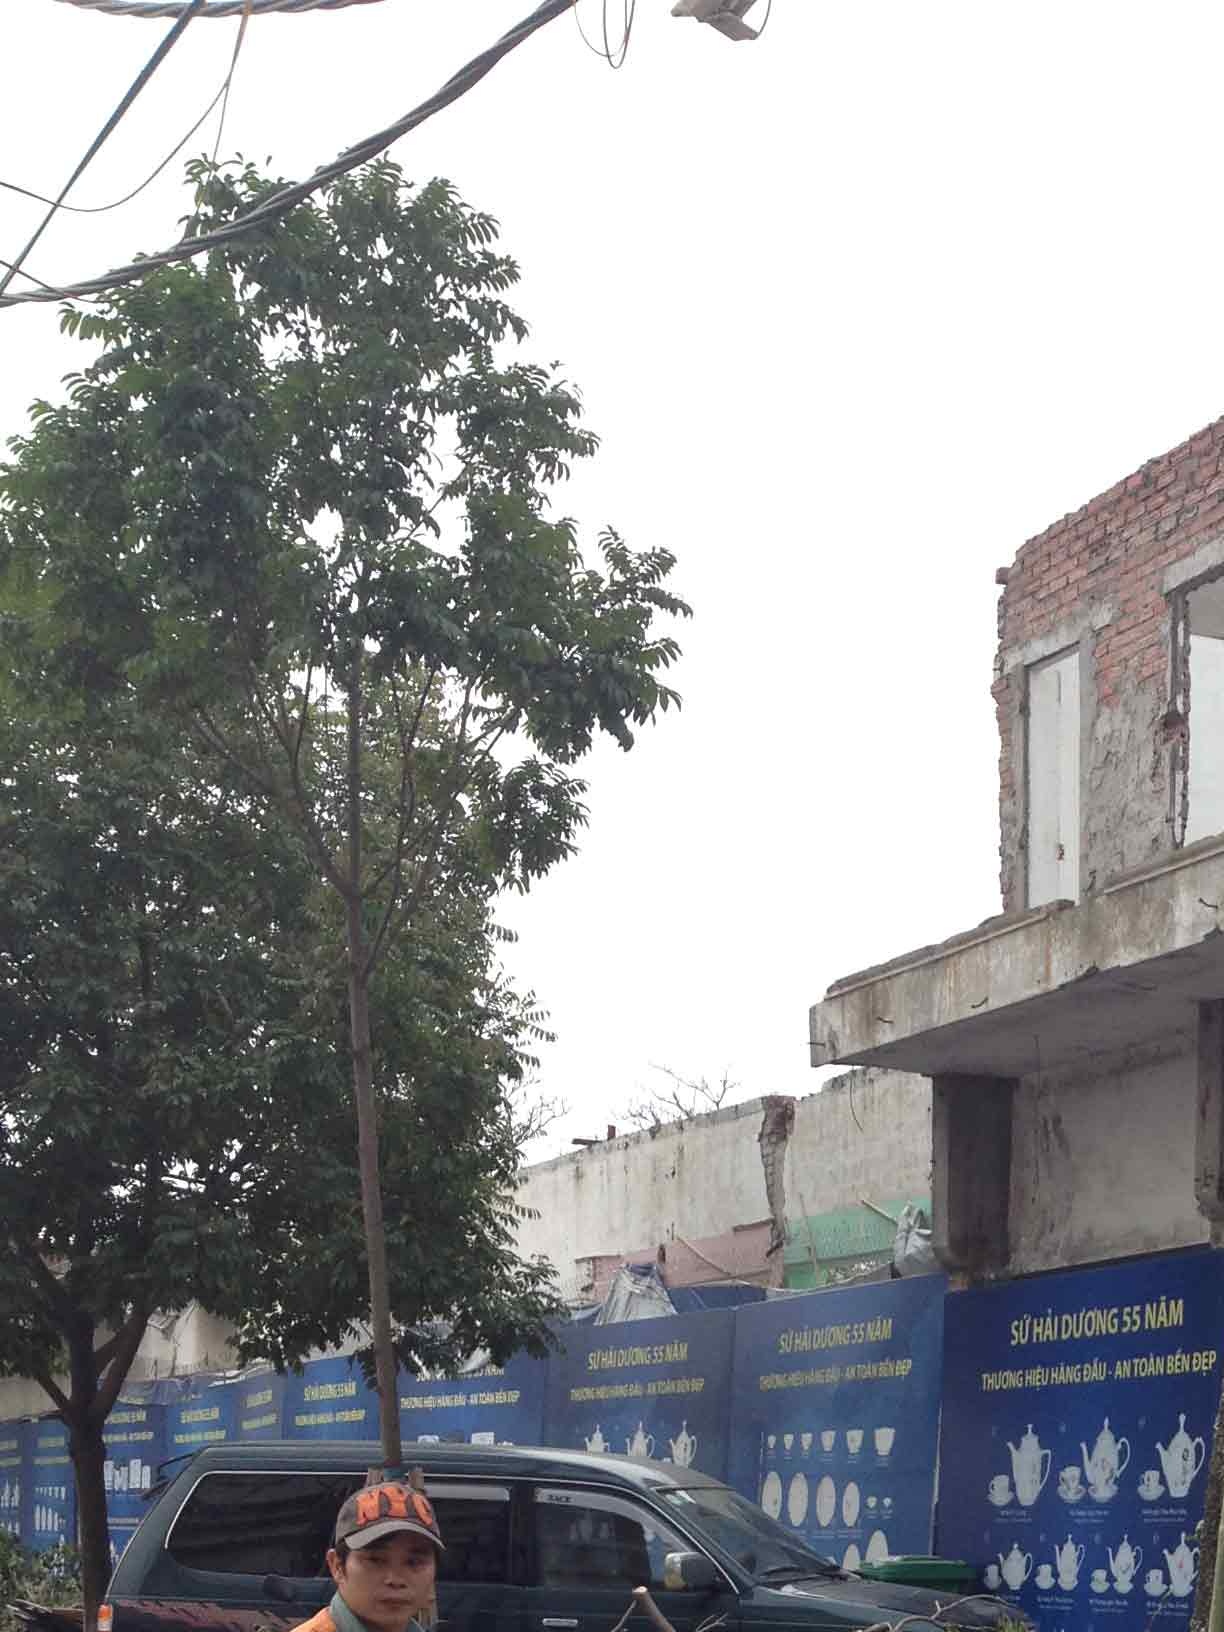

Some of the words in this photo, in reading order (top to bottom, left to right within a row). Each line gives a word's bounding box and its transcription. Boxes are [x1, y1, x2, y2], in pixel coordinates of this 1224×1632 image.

[1010, 1314, 1032, 1346] SỨ
[1032, 1308, 1058, 1343] HẢI
[1061, 1306, 1119, 1341] DƯƠNG
[1122, 1305, 1141, 1334] 55
[1145, 1295, 1185, 1330] NĂM
[1114, 1360, 1131, 1380] AN
[1133, 1355, 1165, 1378] TOÀN
[1192, 1350, 1217, 1377] ĐẸP
